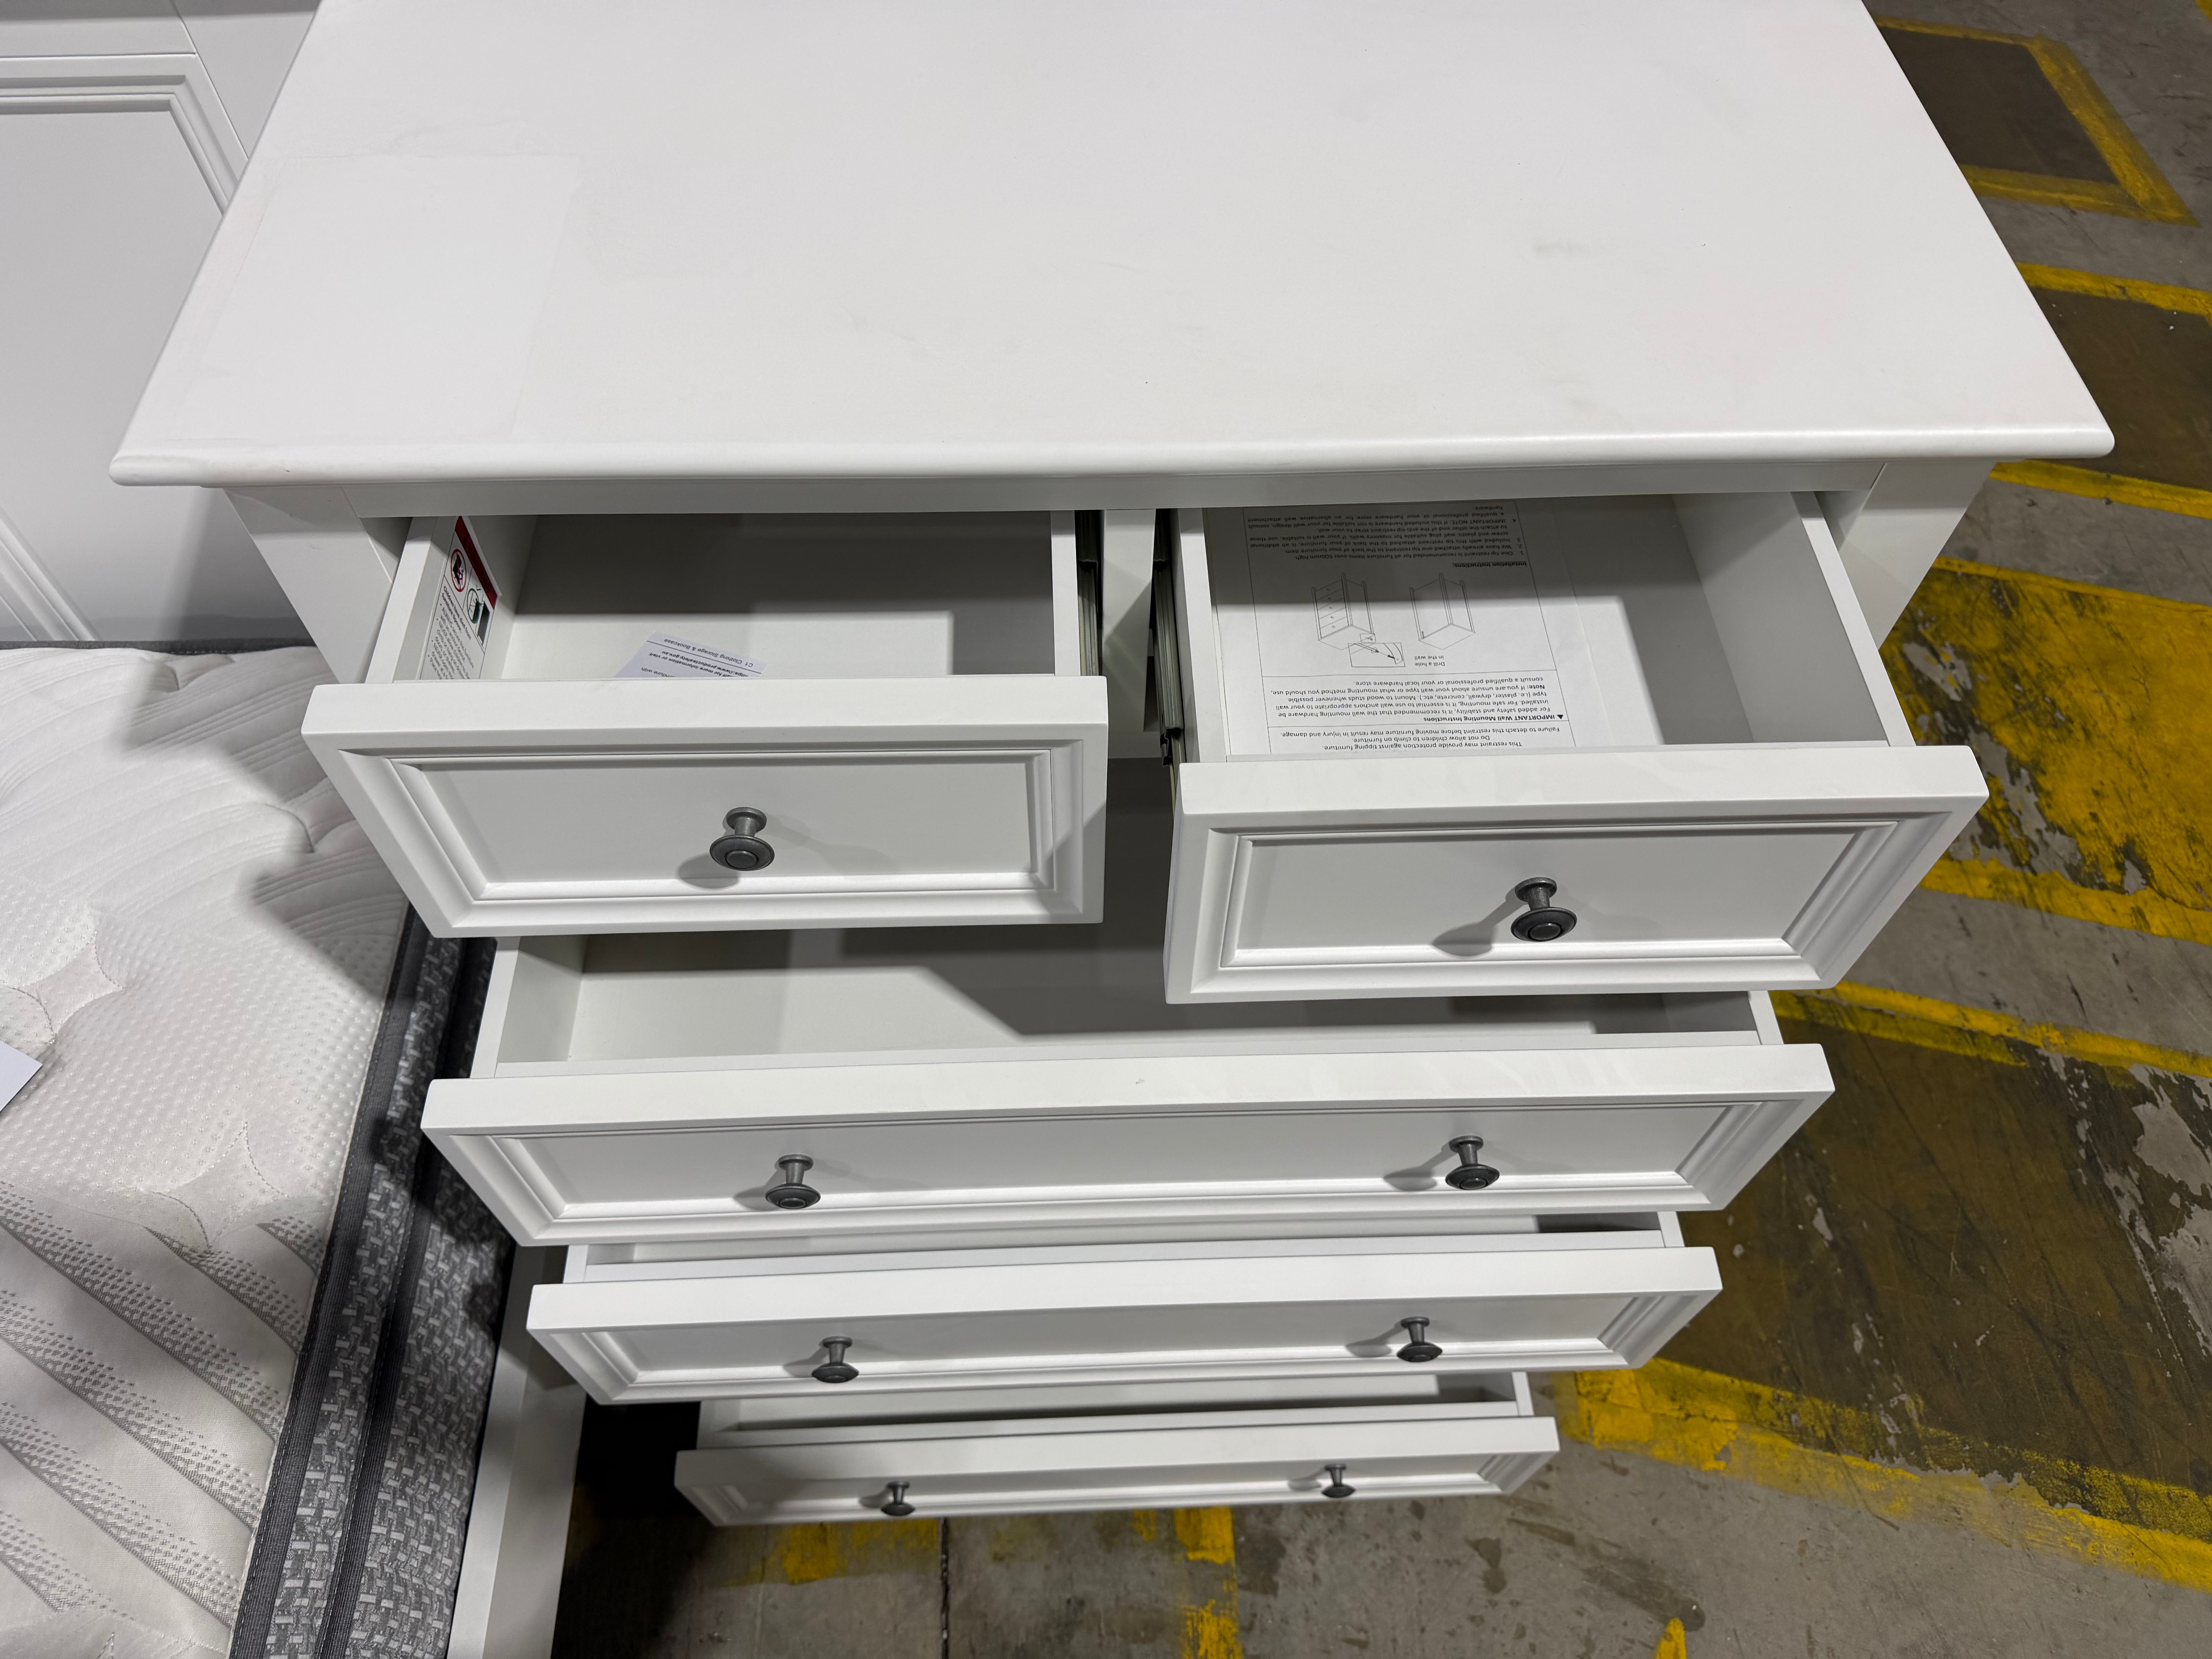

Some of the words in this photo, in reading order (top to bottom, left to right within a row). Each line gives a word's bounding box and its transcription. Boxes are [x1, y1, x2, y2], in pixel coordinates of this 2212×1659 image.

[664, 639, 691, 649] Bookcase
[697, 649, 718, 658] Storage
[668, 658, 699, 669] information
[720, 654, 742, 664] Clothing
